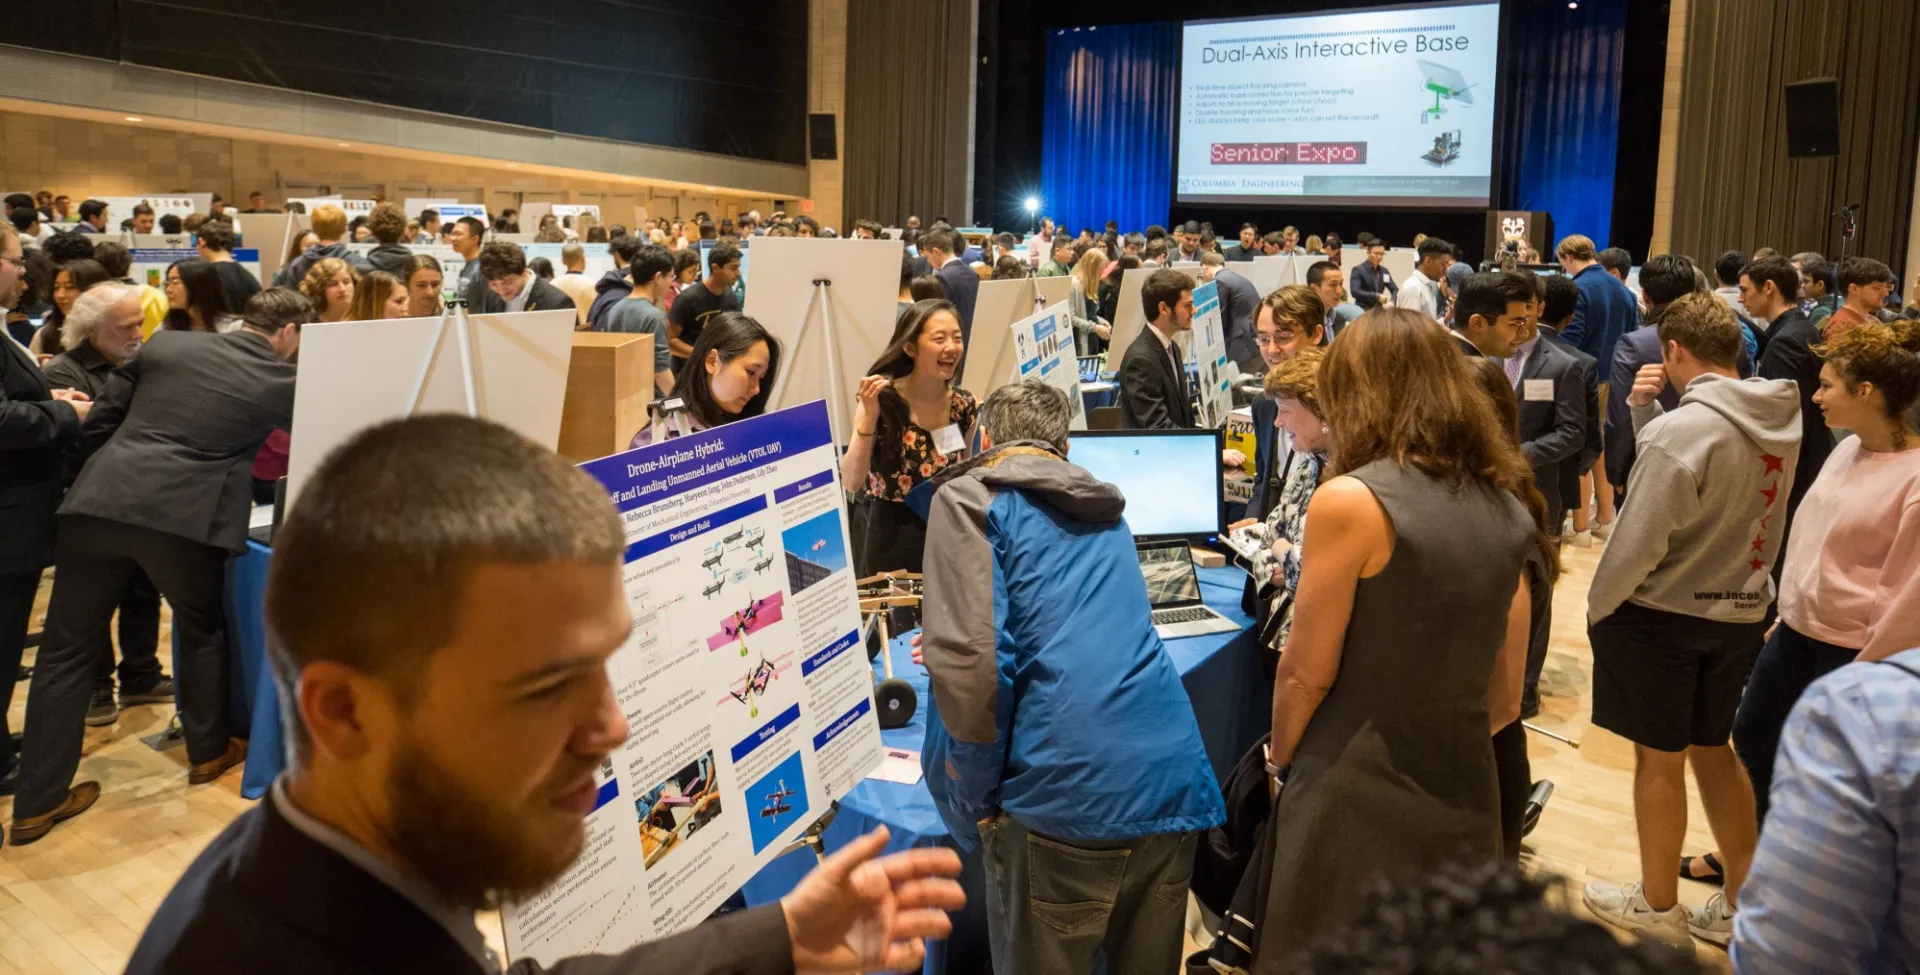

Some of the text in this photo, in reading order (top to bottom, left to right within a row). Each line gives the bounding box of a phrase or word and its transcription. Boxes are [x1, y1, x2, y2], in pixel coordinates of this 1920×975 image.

[1202, 34, 1469, 64] Dual-Axis Interactive Base
[1227, 83, 1249, 91] object
[1250, 82, 1277, 90] tracking
[1321, 88, 1354, 96] targeting
[1242, 100, 1267, 108] moving
[1211, 143, 1357, 164] Senior Expo
[627, 438, 725, 478] Drone-Airplane Hybrid:
[609, 441, 782, 504] off and Landing Unmanned Aerial Vehicle (VTOL UAV)
[626, 509, 652, 523] Rebecca
[720, 479, 734, 491] John
[757, 468, 767, 478] Lily
[766, 465, 778, 475] Zhao
[623, 525, 645, 537] rtment
[645, 521, 652, 531] of
[651, 512, 680, 528] Mechanical
[708, 495, 730, 508] Columbia
[729, 487, 751, 500] University
[669, 520, 711, 543] Design and Build
[617, 686, 628, 696] Four
[643, 766, 659, 780] shaped
[593, 842, 603, 854] and
[533, 901, 540, 909] is
[577, 865, 588, 877] and
[587, 856, 599, 870] load
[518, 903, 552, 930] calculations
[553, 893, 566, 905] were
[566, 871, 594, 897] performed
[594, 866, 600, 875] to
